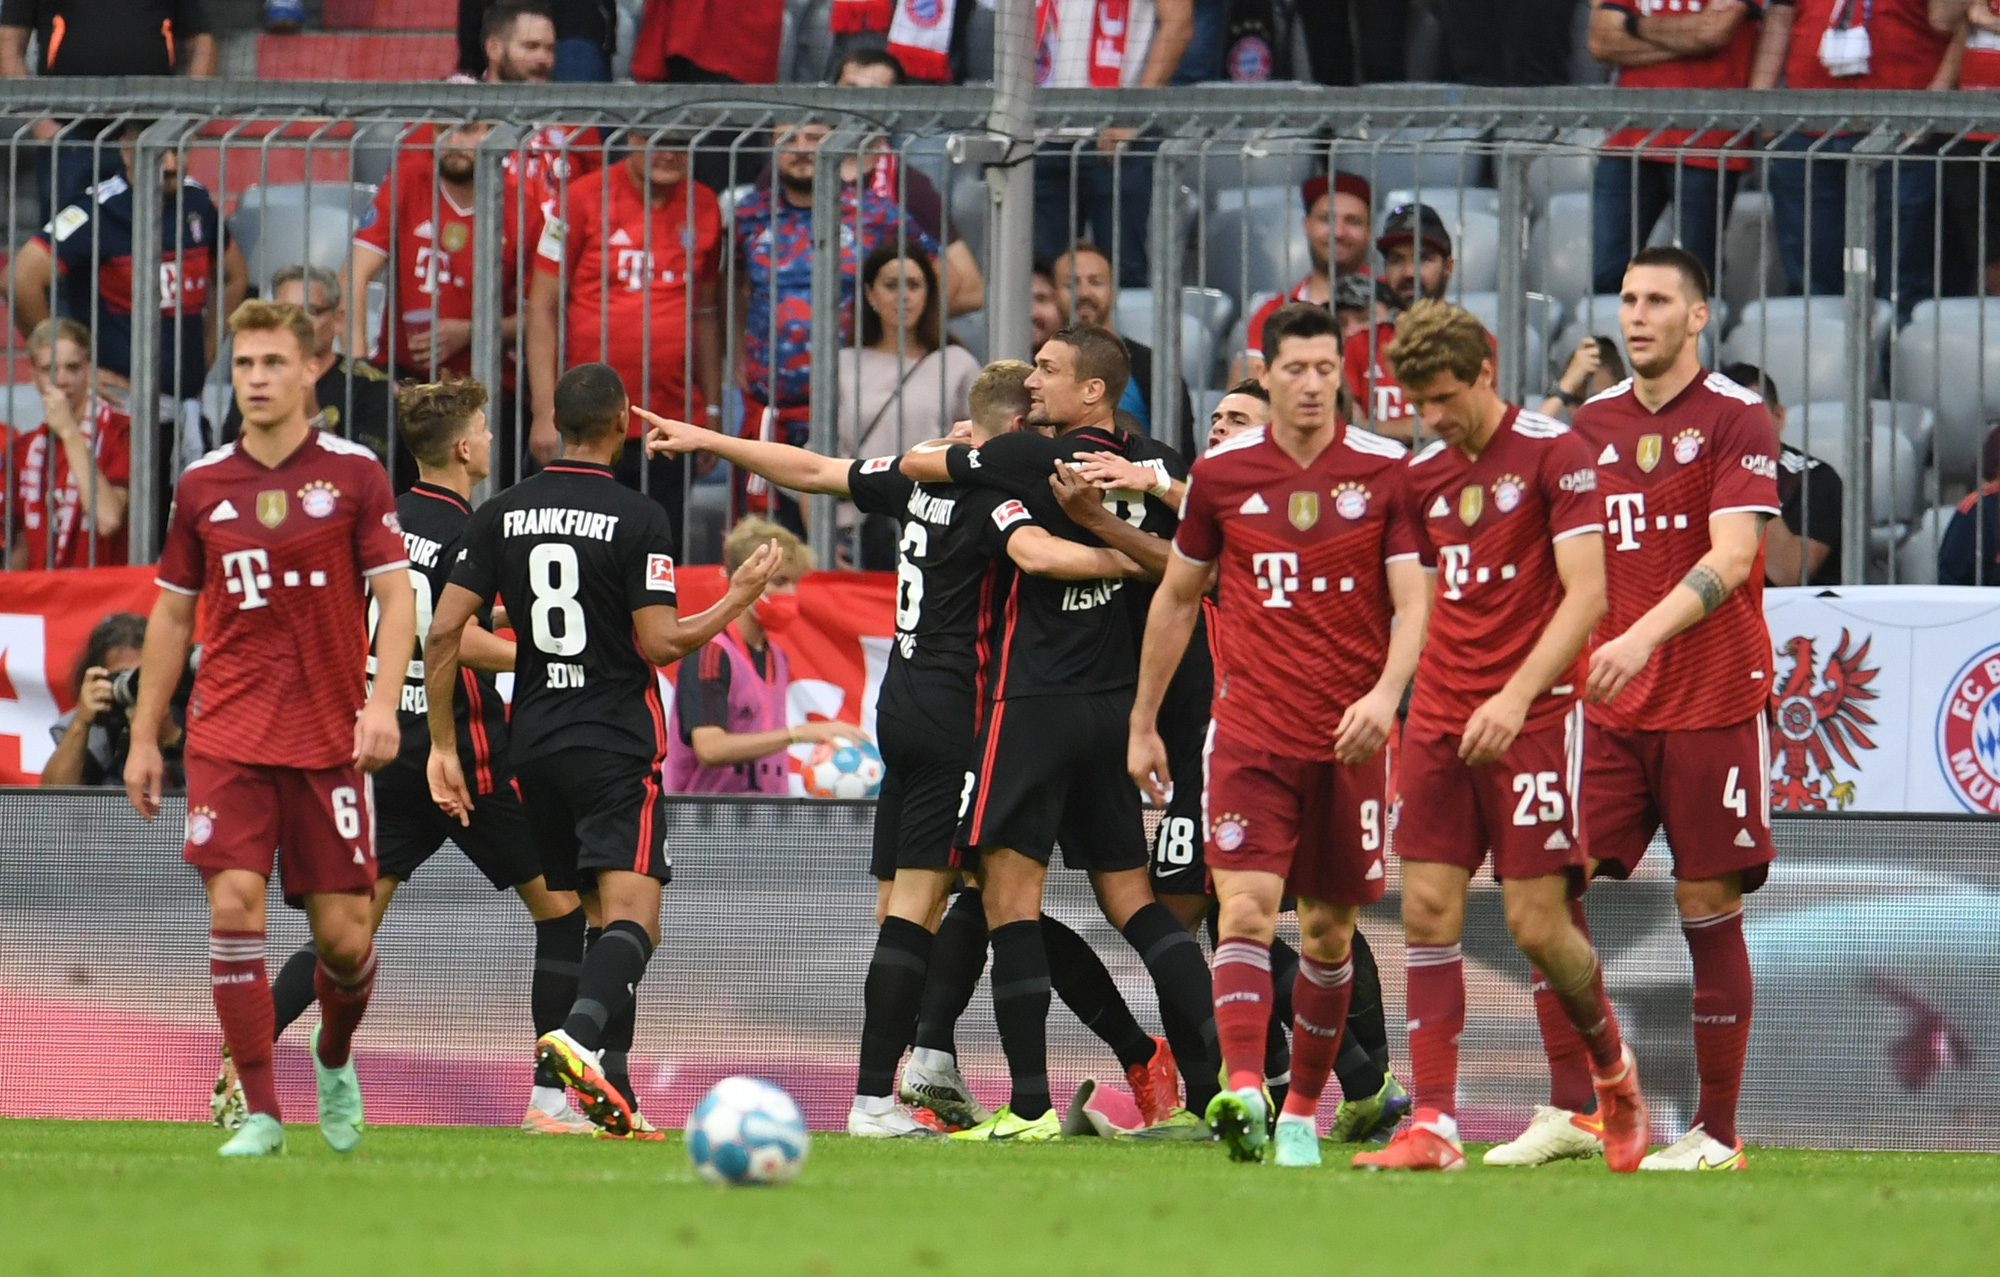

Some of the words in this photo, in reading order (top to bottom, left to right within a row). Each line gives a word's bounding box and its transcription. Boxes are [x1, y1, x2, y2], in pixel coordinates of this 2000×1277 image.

[503, 508, 619, 542] FRANKFURT
[528, 543, 587, 657] 8
[546, 663, 586, 689] SOW
[1951, 678, 1985, 721] FC
[331, 785, 360, 839] 6
[1512, 771, 1564, 826] 25
[1722, 766, 1747, 818] 4
[1157, 816, 1195, 865] 18
[1360, 799, 1380, 850] 9
